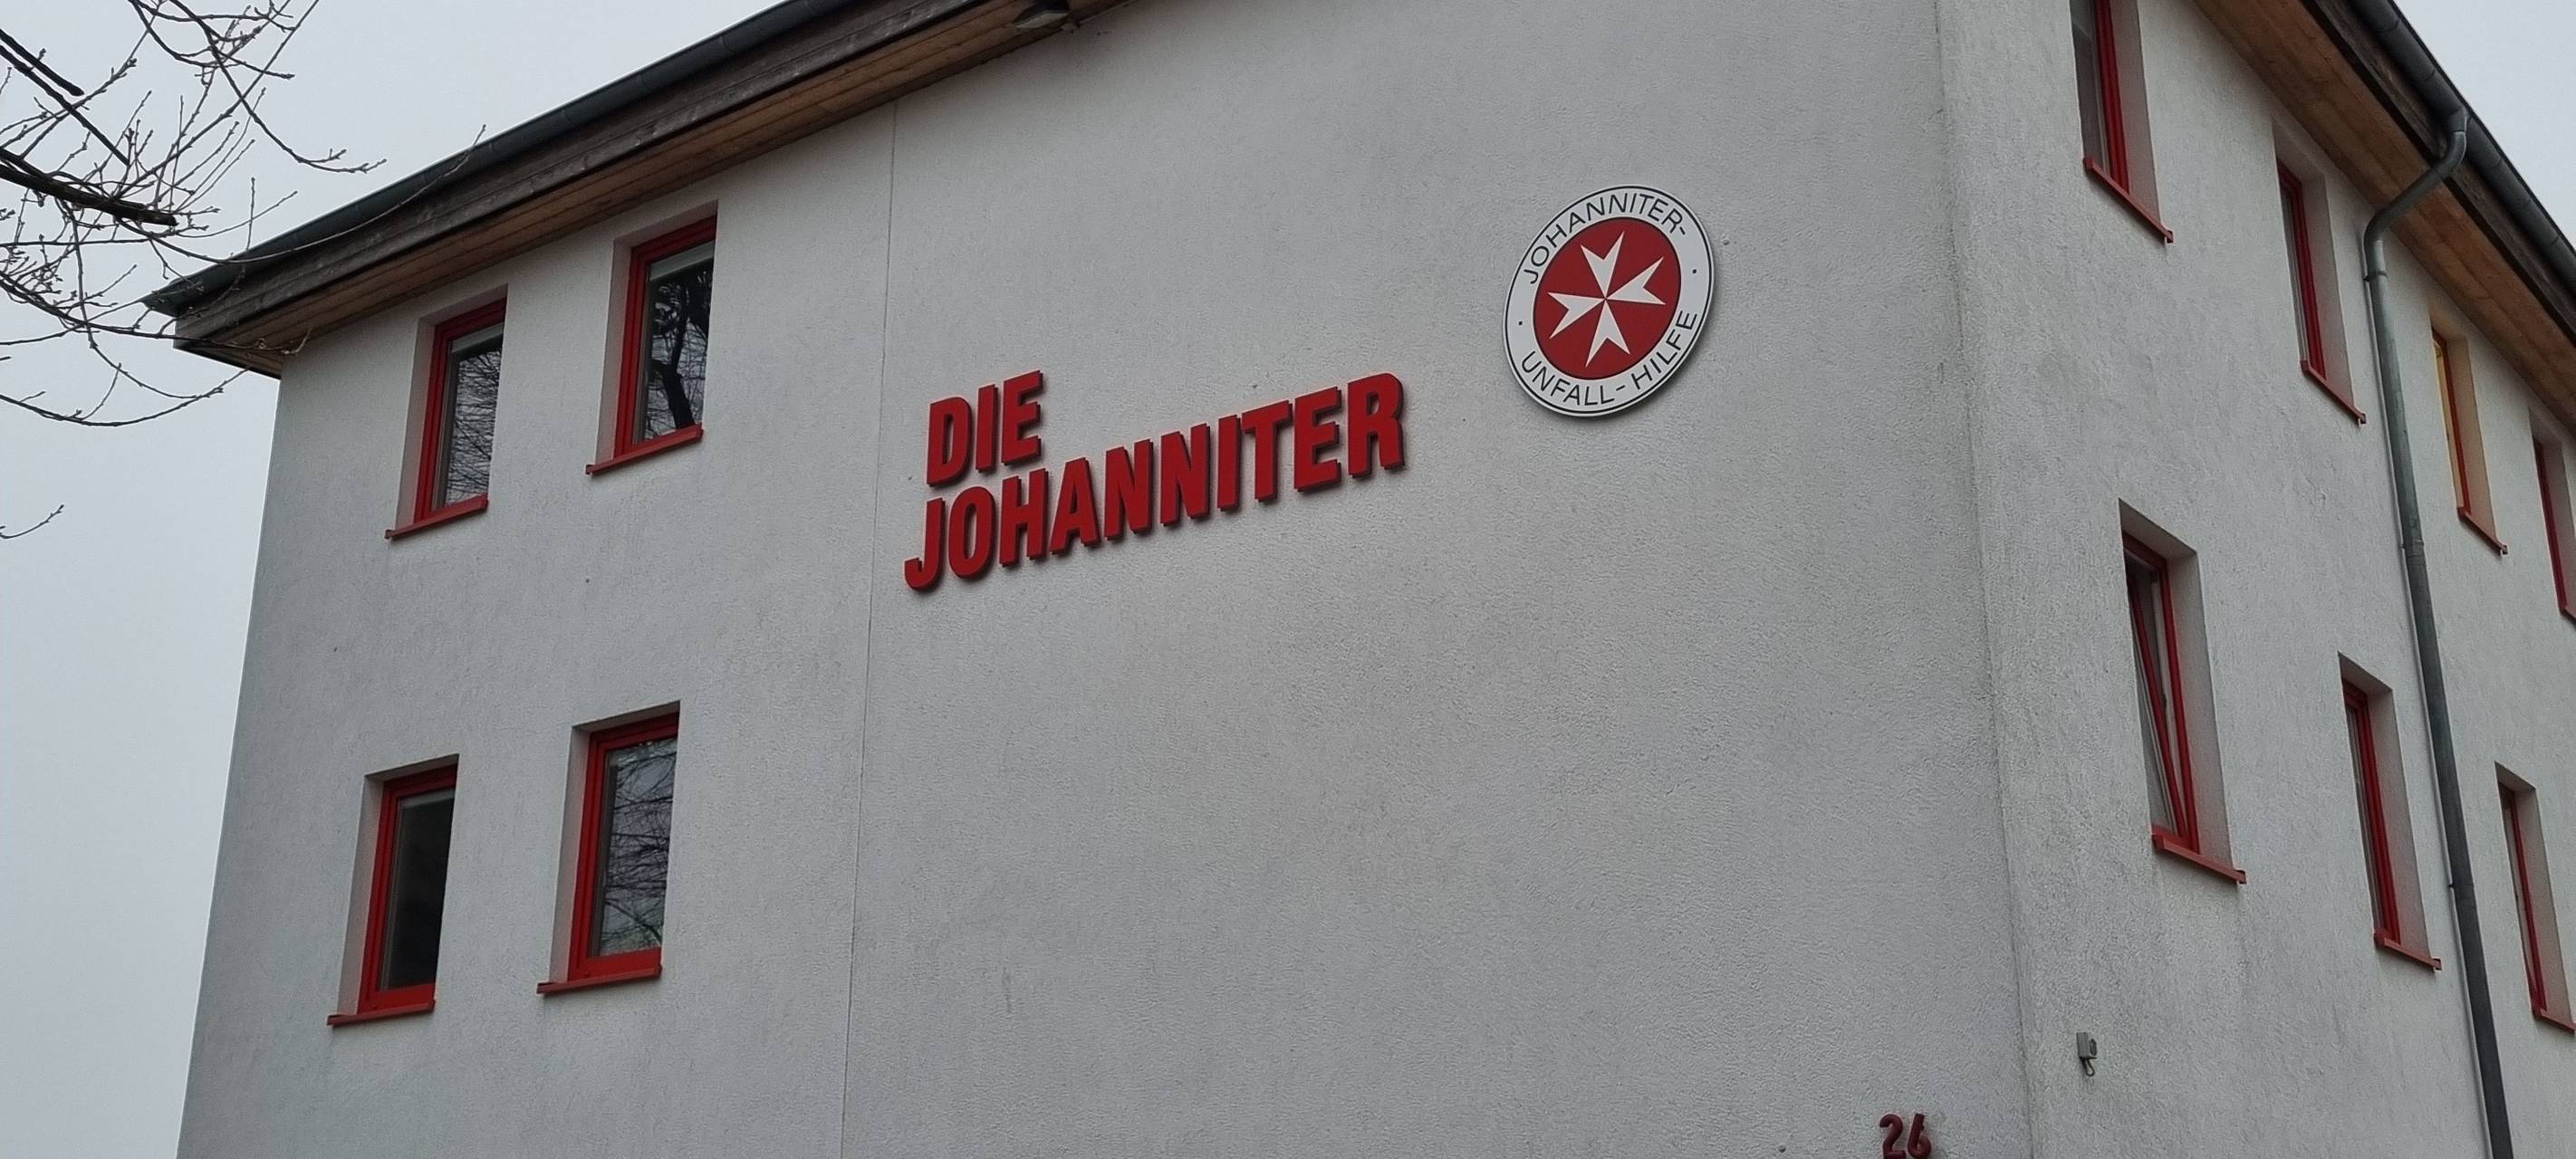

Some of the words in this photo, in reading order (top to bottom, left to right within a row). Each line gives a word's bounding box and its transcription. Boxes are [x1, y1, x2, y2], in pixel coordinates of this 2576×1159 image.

[1523, 192, 1687, 284] JOHANNITER-
[926, 369, 1043, 486] DIE
[904, 372, 1405, 591] JOHANNITER
[1879, 1113, 1932, 1159] 26
